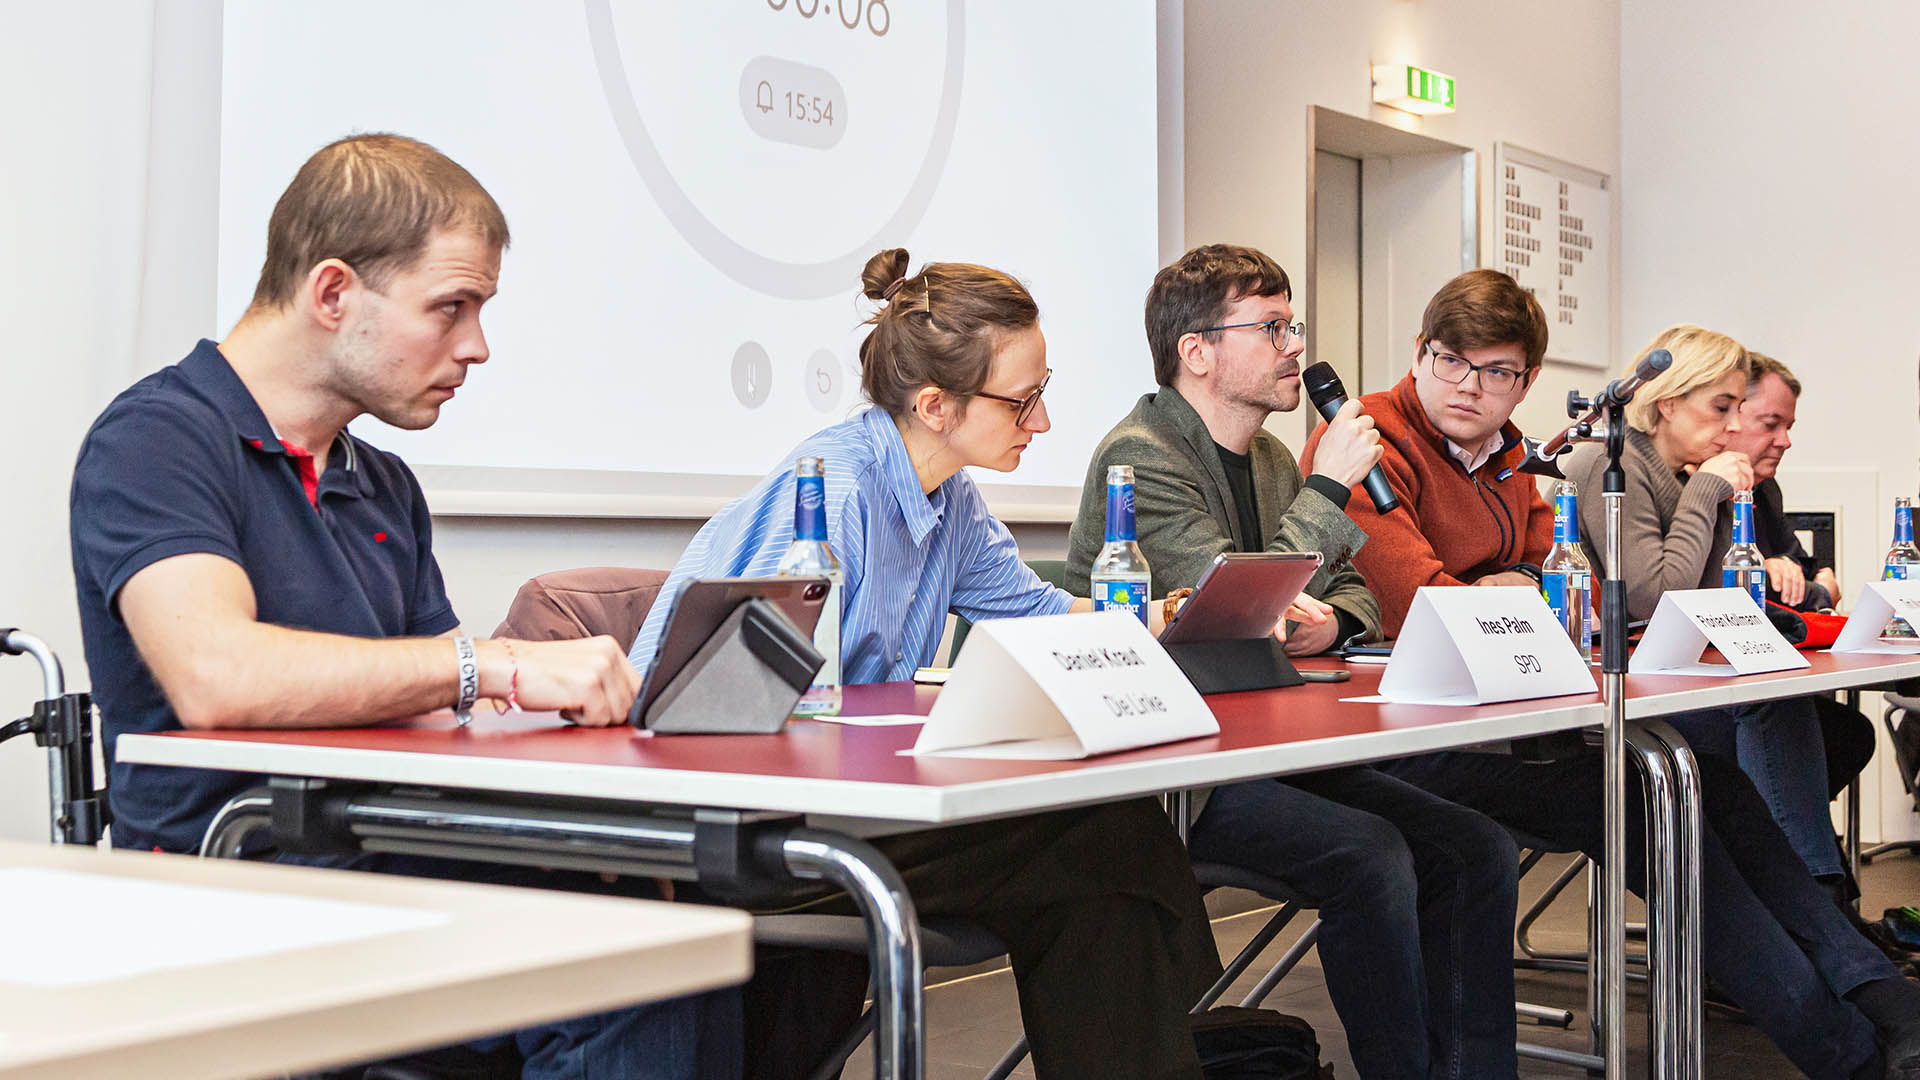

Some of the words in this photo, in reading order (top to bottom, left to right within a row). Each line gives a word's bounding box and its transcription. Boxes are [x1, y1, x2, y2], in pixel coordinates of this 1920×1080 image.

[784, 90, 835, 127] 15:54
[1475, 616, 1506, 635] Ines
[1501, 616, 1536, 634] Palm
[1052, 647, 1106, 671] Daniel
[1514, 654, 1542, 674] SPD
[1103, 694, 1135, 718] Die
